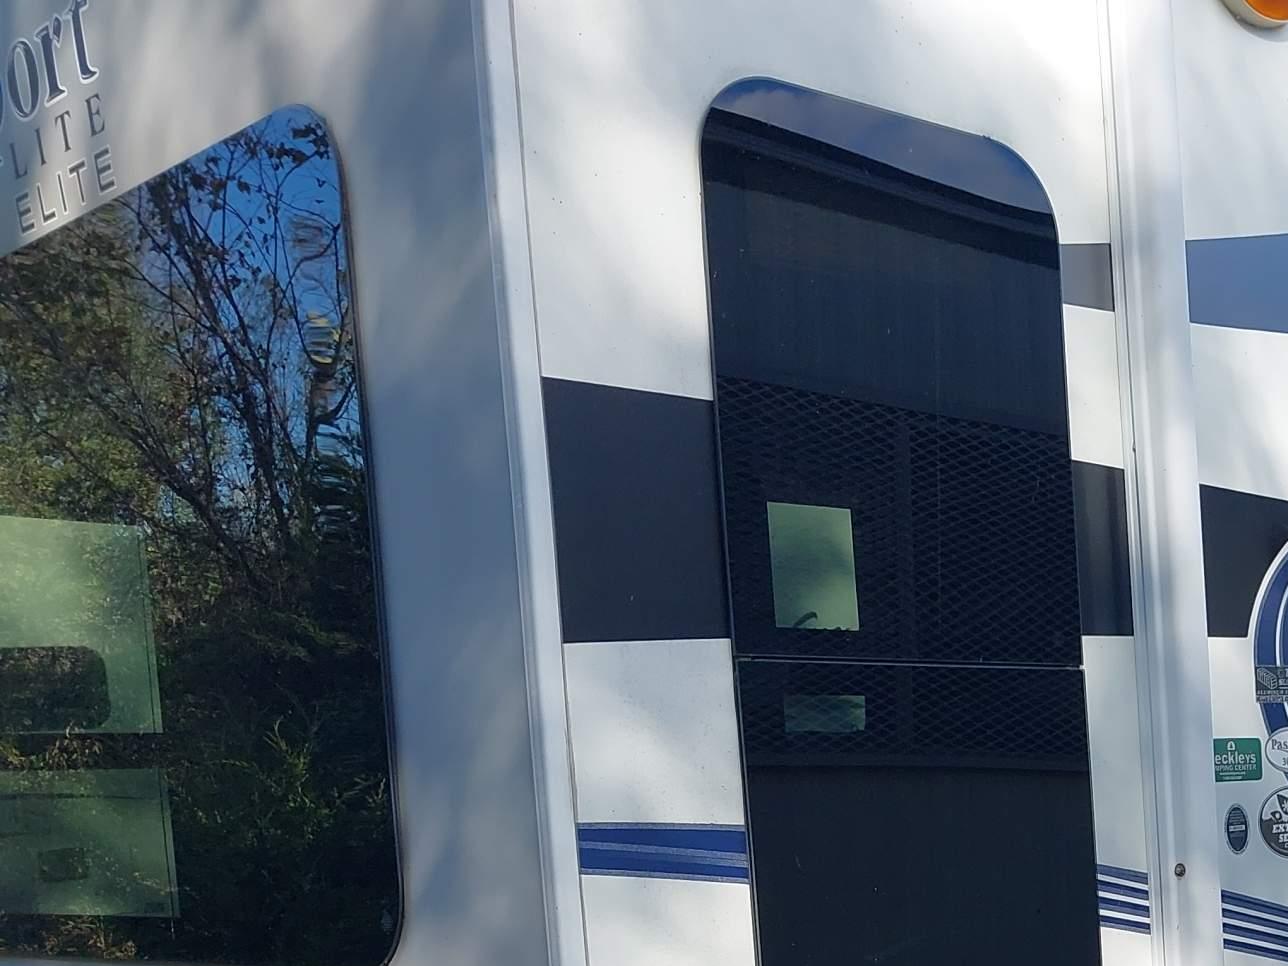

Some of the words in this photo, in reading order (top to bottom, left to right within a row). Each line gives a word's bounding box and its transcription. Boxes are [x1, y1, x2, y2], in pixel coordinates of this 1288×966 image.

[0, 0, 99, 120] ort
[10, 93, 106, 180] LITE
[15, 146, 118, 235] ELITE
